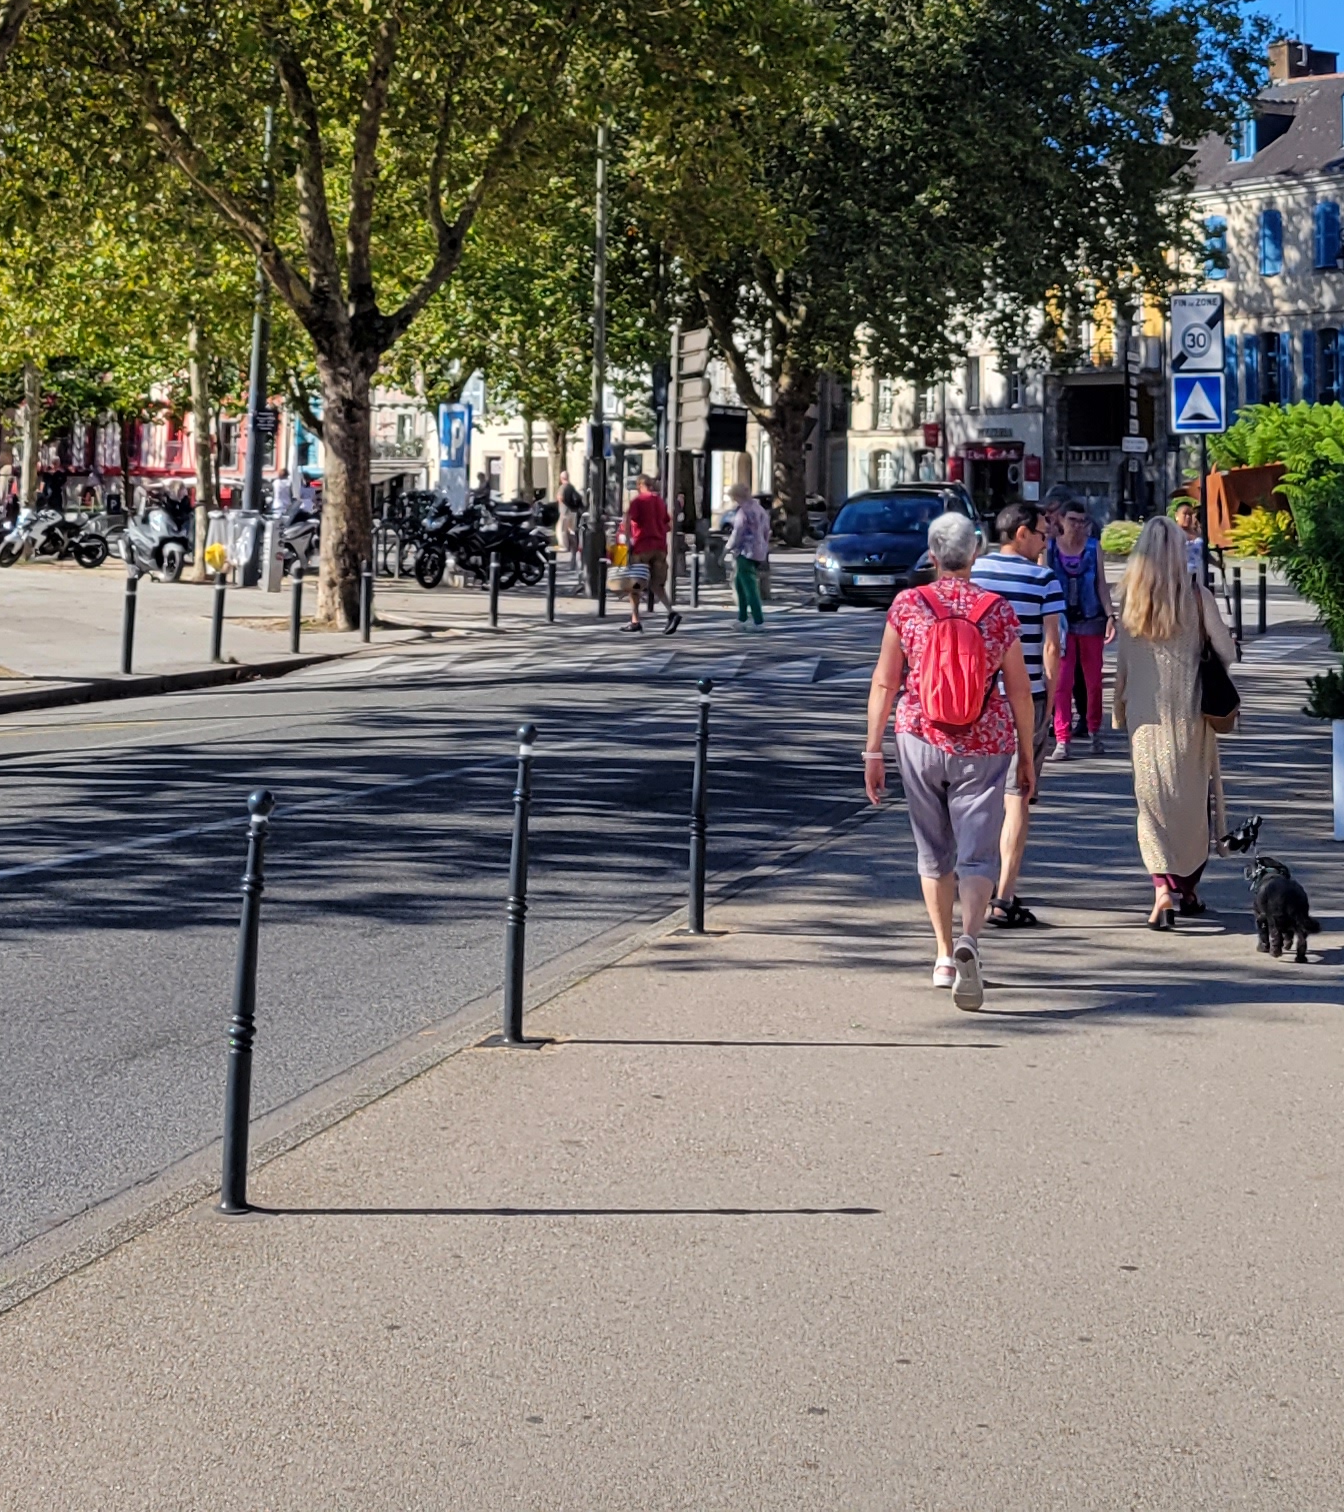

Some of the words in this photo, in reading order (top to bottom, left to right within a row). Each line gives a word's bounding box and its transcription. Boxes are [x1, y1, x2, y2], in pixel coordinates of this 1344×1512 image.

[1174, 299, 1187, 307] FIN
[1196, 297, 1218, 307] ZONE
[1187, 332, 1207, 349] 30
[451, 418, 465, 461] P
